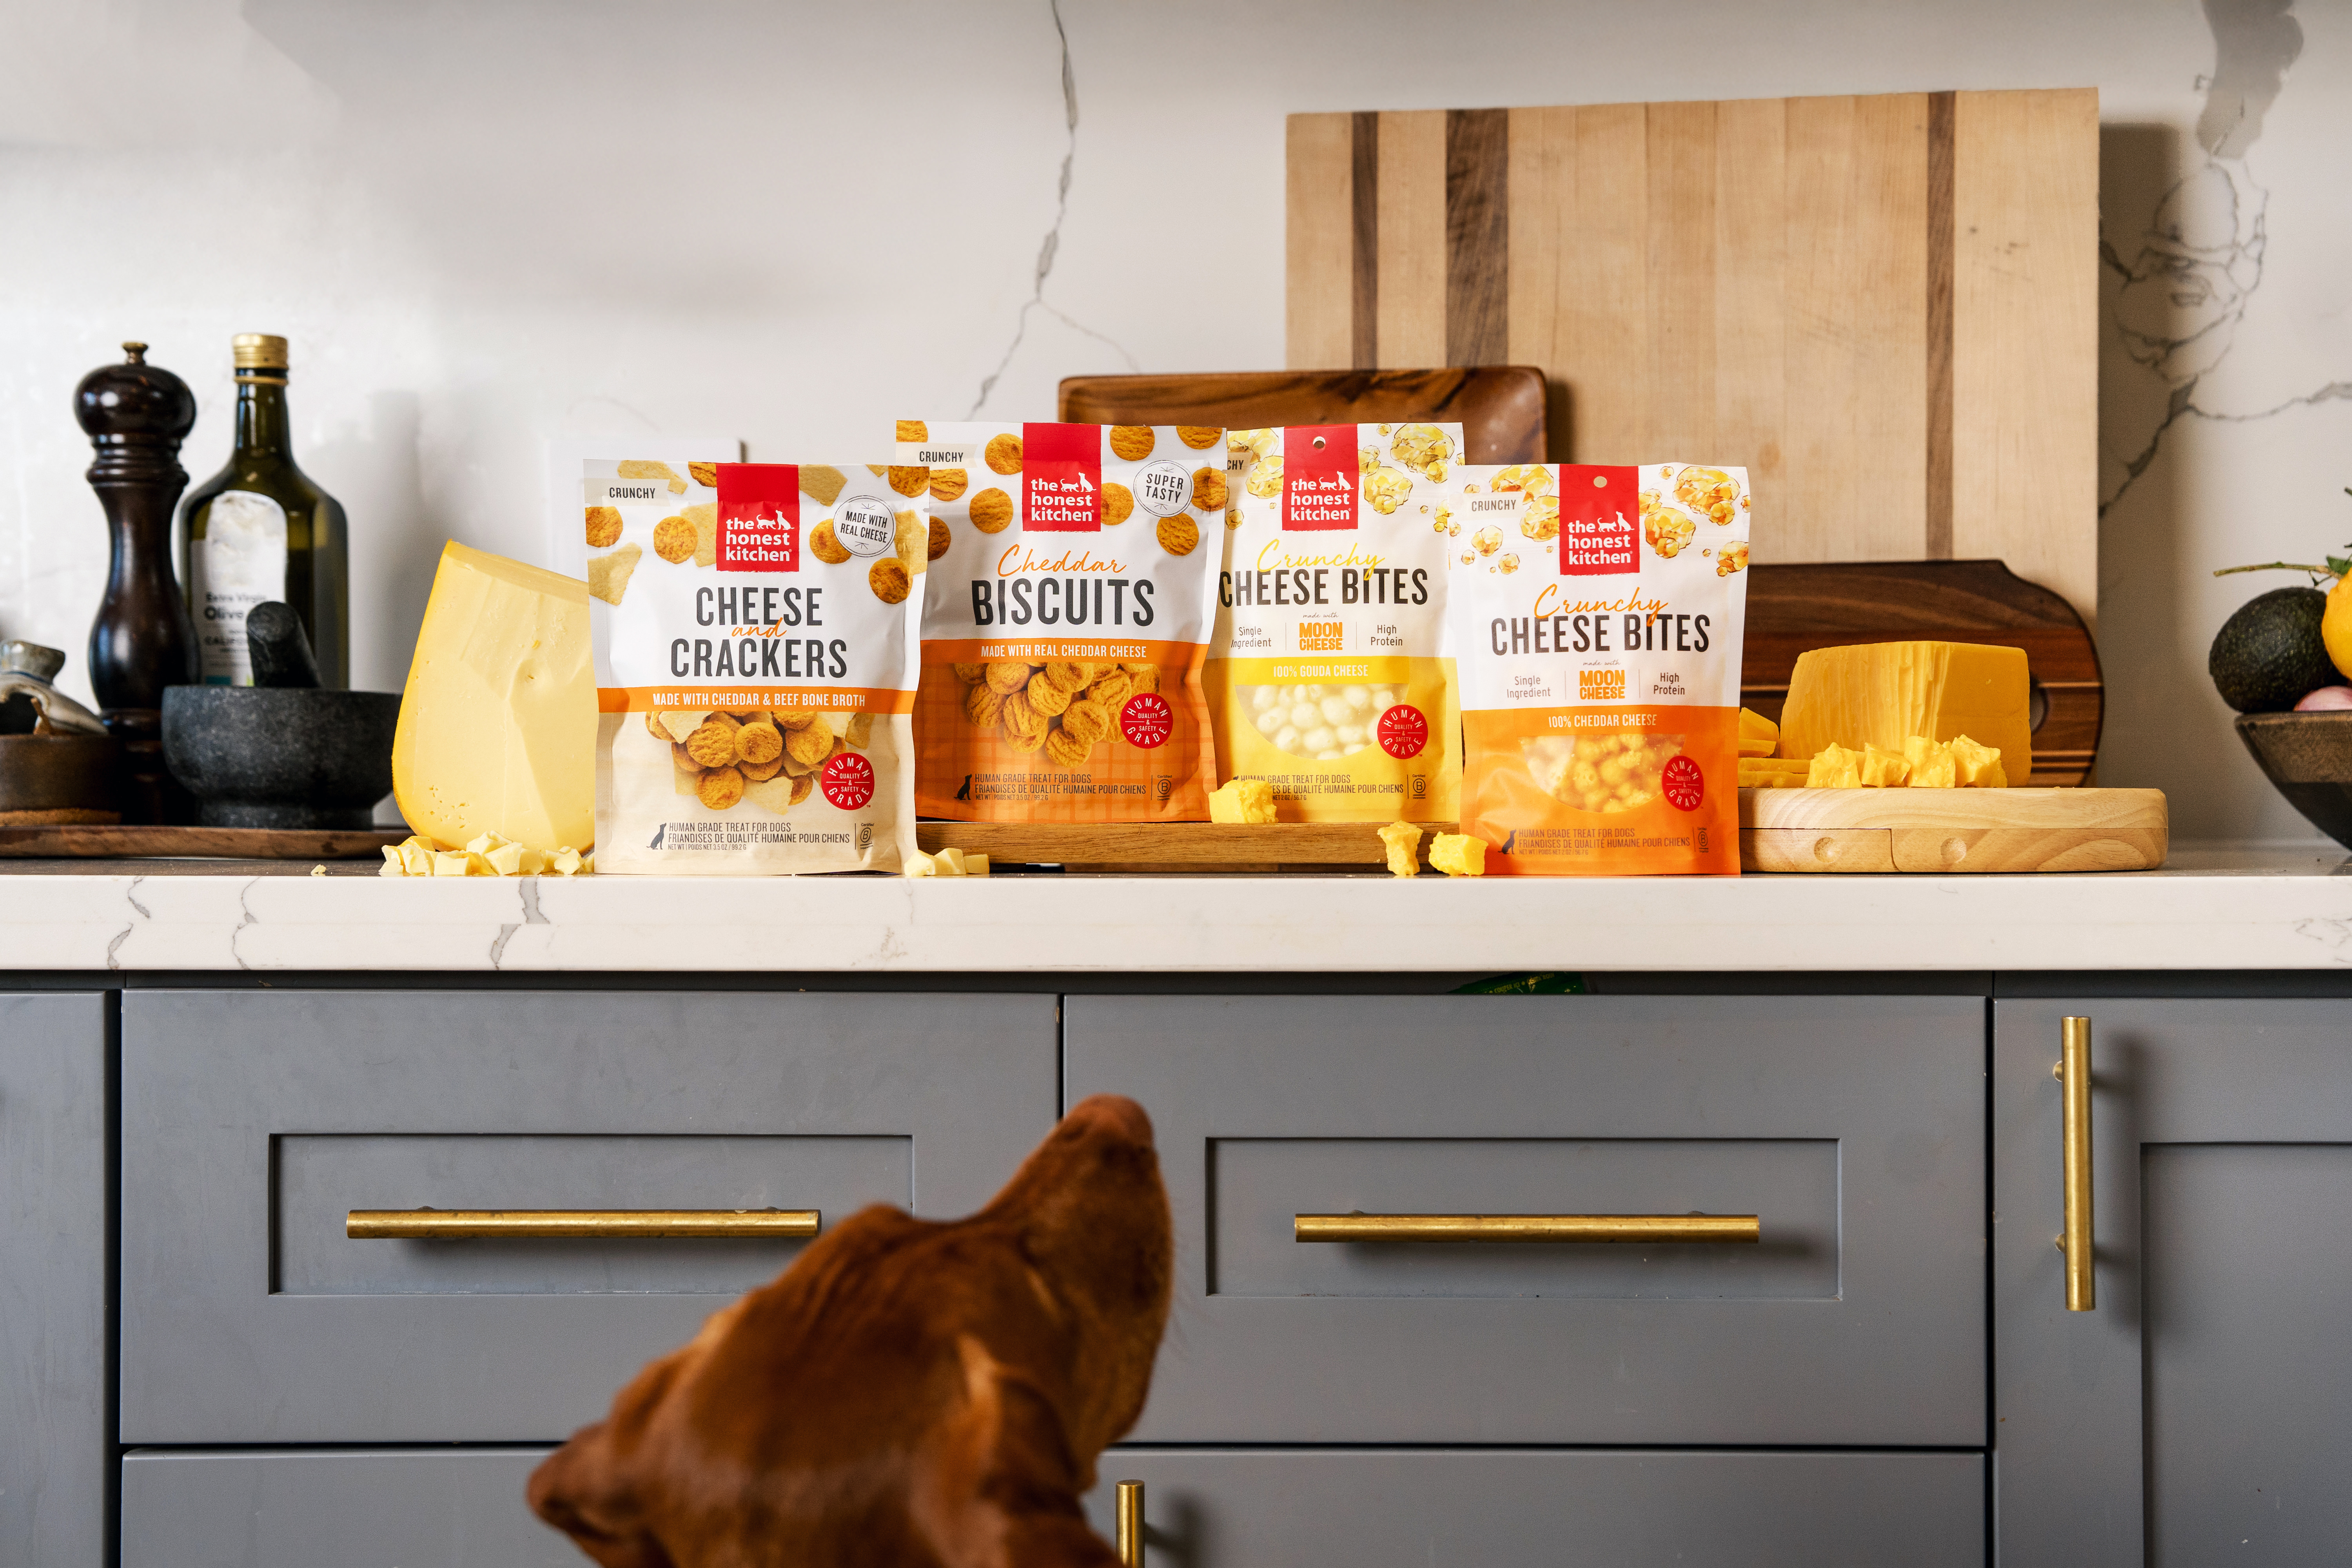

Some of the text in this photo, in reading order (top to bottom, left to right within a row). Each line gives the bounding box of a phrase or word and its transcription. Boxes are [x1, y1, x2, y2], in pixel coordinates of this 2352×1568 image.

[919, 451, 964, 463] CRUNCHY
[1031, 478, 1058, 491] the
[1146, 473, 1184, 490] SUPER
[1292, 479, 1316, 491] the
[609, 487, 656, 499] CRUNCHY
[1145, 485, 1181, 503] TASTY
[1291, 492, 1349, 505] honest
[1031, 494, 1092, 506] honest
[1472, 500, 1516, 512] CRUNCHY
[726, 518, 754, 530] the
[846, 510, 888, 528] MADE WITH
[840, 523, 888, 543] REAL CHEESE
[1568, 520, 1595, 533] the
[726, 532, 790, 546] honest
[1568, 535, 1630, 549] honest
[997, 544, 1127, 577] Cheddar
[1257, 539, 1385, 581] Crunchy
[1220, 569, 1428, 608] CHEESE BITES
[697, 587, 822, 626] CHEESE
[972, 578, 1154, 626] BISCUITS
[1534, 583, 1669, 626] Crunchy
[731, 617, 787, 638] and
[1239, 626, 1261, 635] Single
[1299, 622, 1342, 638] MOON
[1377, 625, 1397, 634] High
[1370, 636, 1403, 646] Protein
[1491, 614, 1710, 656] CHEESE BITES
[1231, 638, 1271, 648] Ingredient
[1299, 638, 1342, 650] CHEESE
[981, 644, 1146, 658] MADE WITH REAL CHEDDAR CHEESE
[671, 639, 847, 678] CRACKERS
[1274, 664, 1368, 677] 100% GOUDA CHEESE
[1514, 676, 1541, 686] Single
[1579, 670, 1625, 686] MOON
[1660, 672, 1679, 683] High
[1507, 688, 1550, 699] Ingredient
[1580, 686, 1625, 700] CHEESE
[1653, 685, 1685, 695] Protein
[653, 693, 865, 706] MADE WITH CHEDDAR & BEEF BONE BROTH
[1127, 698, 1168, 717] HUMAN
[1383, 710, 1423, 728] HUMAN
[1548, 714, 1657, 728] 100% CHEDDAR CHEESE
[1127, 727, 1167, 744] GRADE
[1384, 738, 1422, 755] GRADE
[828, 757, 870, 777] HUMAN
[1667, 761, 1699, 780] HUMAN
[975, 773, 1091, 784] HUMAN GRADE TREAT FOR DOGS
[1268, 775, 1290, 784] GRADE
[1292, 775, 1313, 784] TREAT
[1316, 775, 1329, 783] FOR
[1331, 775, 1350, 783] DOGS
[975, 782, 1146, 794] FRIANDISES DE QUALITÉ HUMAINE POUR CHIENS
[1283, 785, 1291, 793] DE
[1294, 783, 1321, 793] QUALITÉ
[1324, 785, 1356, 793] HUMAINE
[1358, 785, 1376, 793] POUR
[1378, 784, 1403, 793] CHIENS
[828, 788, 869, 806] GRADE
[1669, 789, 1700, 807] GRADE
[670, 822, 791, 833] HUMAN GRADE TREAT FOR DOGS
[1519, 828, 1635, 837] HUMAN GRADE TREAT FOR DOGS
[669, 831, 849, 843] FRIANDISES DE QUALITÉ HUMAINE POUR CHIENS
[1519, 837, 1690, 848] FRIANDISES DE QUALITÉ HUMAINE POUR CHIENS
